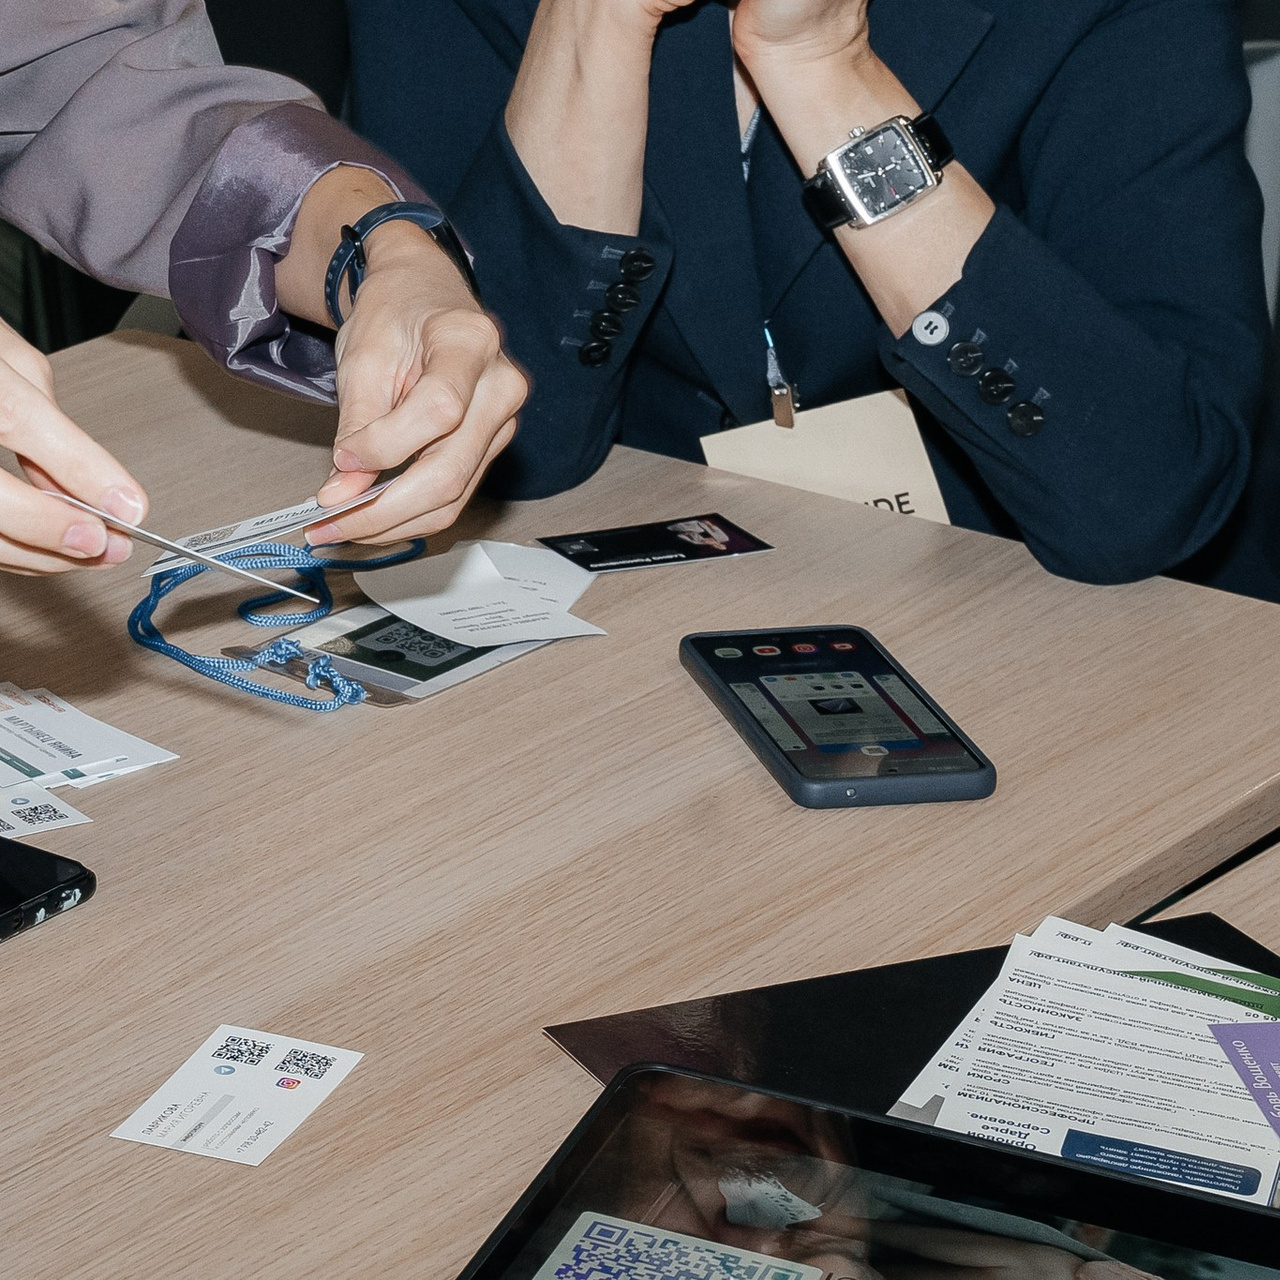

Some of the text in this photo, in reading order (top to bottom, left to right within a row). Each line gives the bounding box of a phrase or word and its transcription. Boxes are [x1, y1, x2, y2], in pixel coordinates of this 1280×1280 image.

[1005, 975, 1042, 989] ЦЕНА
[997, 997, 1083, 1021] ЗАКОННОСТЬ
[987, 1019, 1056, 1039] ГИБКОСТЬ
[976, 1045, 1055, 1067] ГЕОГРАФИЯ
[1232, 1040, 1273, 1089] Вощенко
[965, 1070, 1011, 1085] СРОКИ
[139, 1101, 183, 1135] ЛАВРИКОВА
[956, 1090, 1096, 1125] ПРОФЕССИОНАЛИЗМ
[964, 1110, 1052, 1135] Сергеевне.
[979, 1122, 1030, 1140] Дарье
[1128, 1163, 1183, 1179] таможенную
[1184, 1174, 1239, 1190] Подготовить
